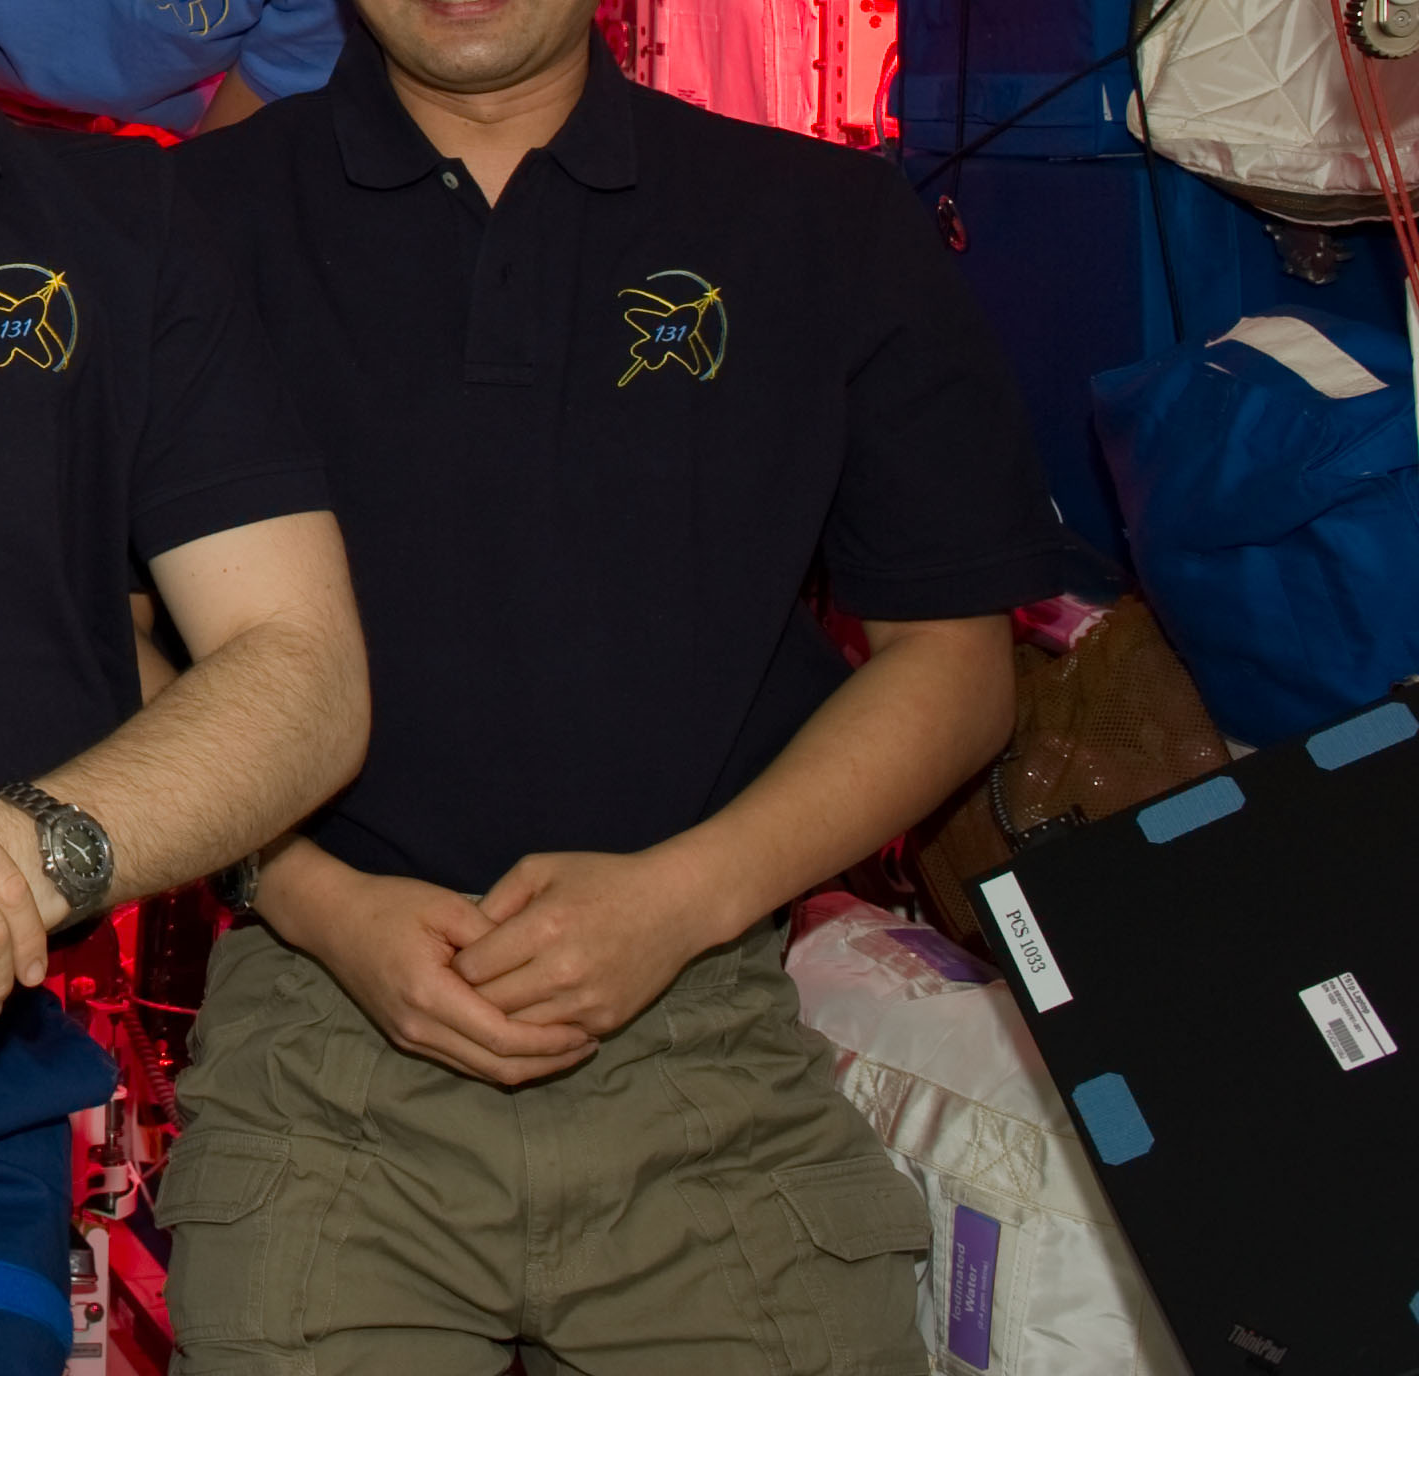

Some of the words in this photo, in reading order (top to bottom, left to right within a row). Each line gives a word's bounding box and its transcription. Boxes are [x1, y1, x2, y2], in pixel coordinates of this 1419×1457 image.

[653, 323, 690, 344] 131
[1006, 909, 1029, 938] PCS
[1019, 939, 1046, 973] 1033
[1341, 973, 1356, 992] T61p
[1351, 990, 1370, 1015] Laptop
[952, 1242, 966, 1321] Iodinated
[964, 1264, 977, 1312] Water
[1228, 1324, 1288, 1364] ThinkPad
